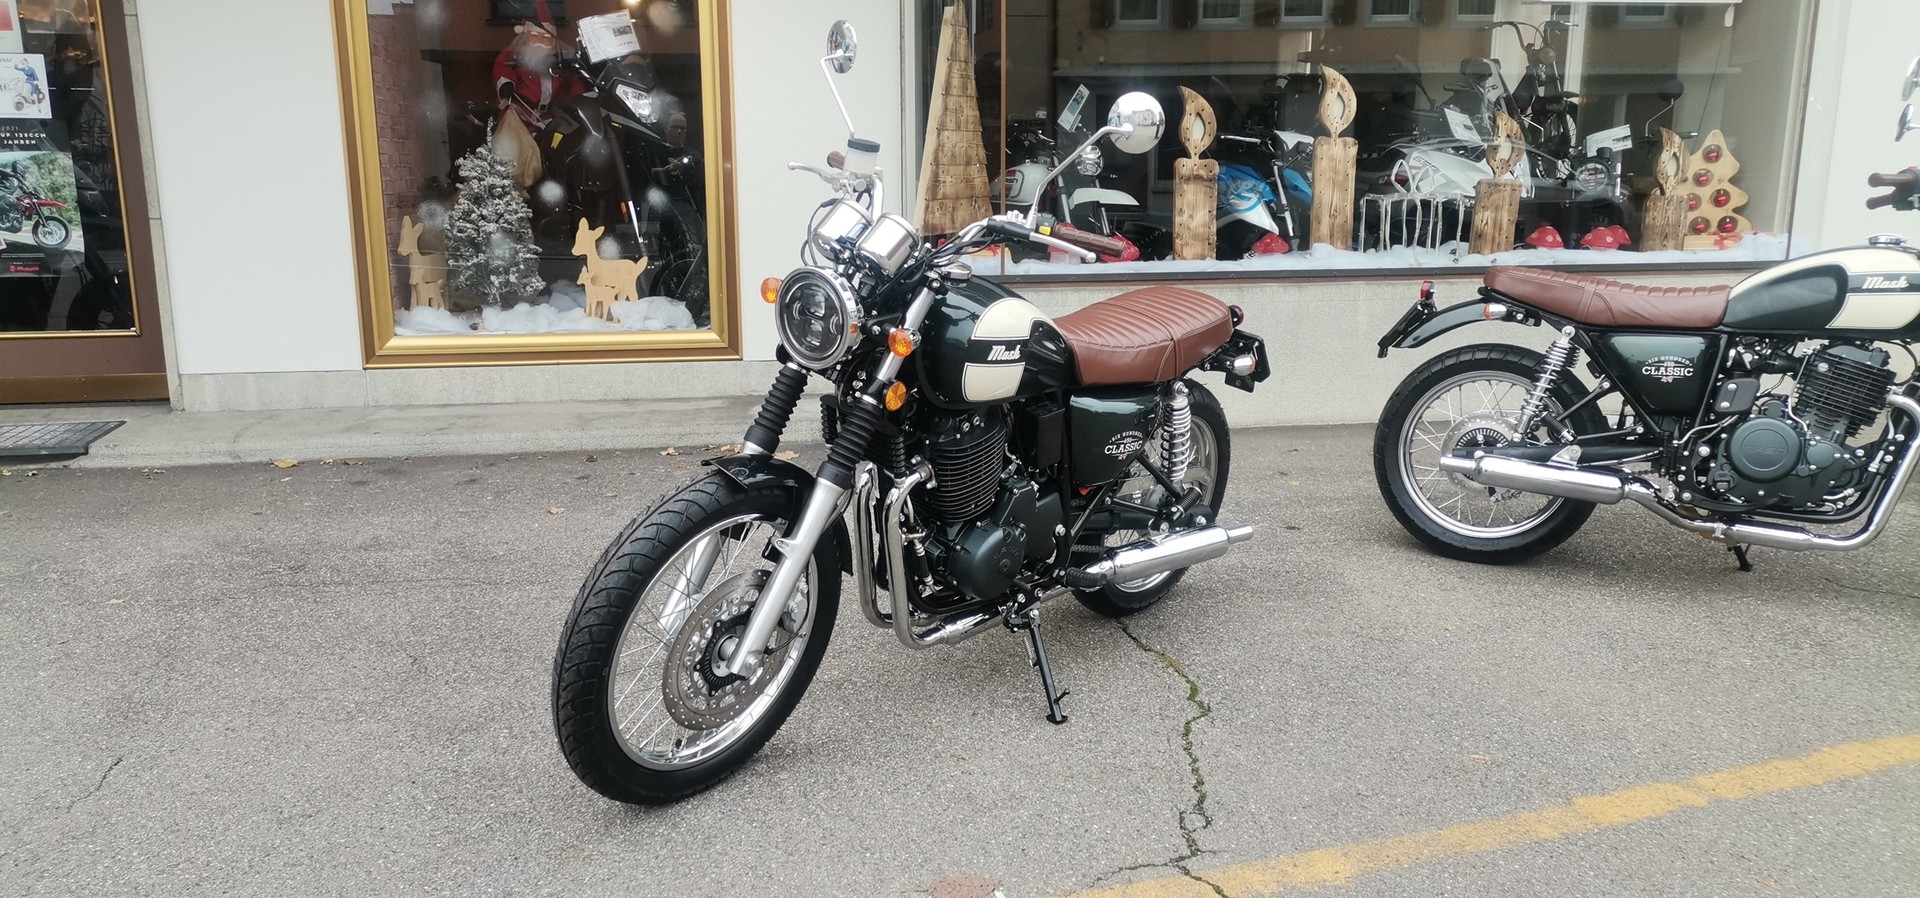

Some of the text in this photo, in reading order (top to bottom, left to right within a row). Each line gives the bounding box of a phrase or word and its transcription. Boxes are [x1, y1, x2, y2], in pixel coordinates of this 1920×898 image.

[1861, 275, 1910, 289] Mash
[986, 344, 1021, 361] Mash
[1660, 355, 1690, 365] HUNDRED
[1641, 366, 1694, 376] CLASSIC
[1104, 440, 1143, 454] CLASSIC
